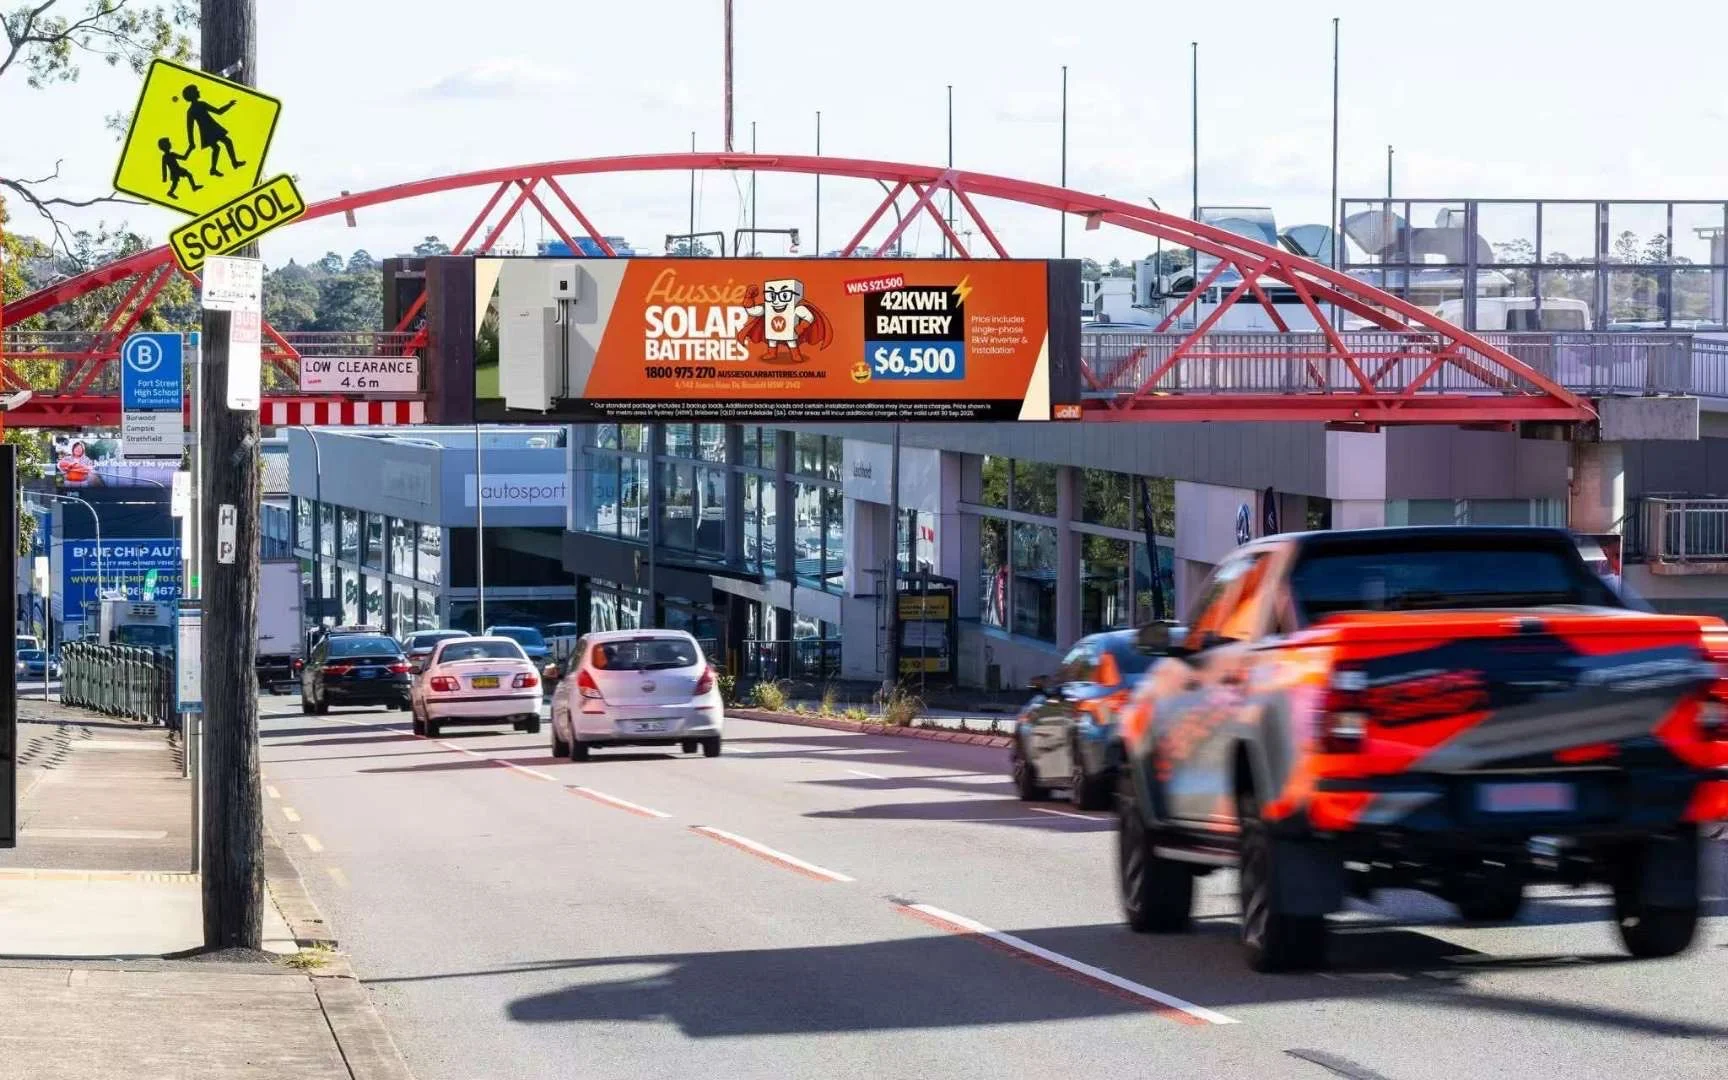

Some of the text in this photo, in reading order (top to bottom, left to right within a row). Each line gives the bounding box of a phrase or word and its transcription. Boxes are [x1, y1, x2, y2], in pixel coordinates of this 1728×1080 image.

[182, 188, 295, 260] SCHOOL
[645, 268, 747, 303] Aussie
[847, 283, 868, 293] WAS
[880, 291, 948, 311] 42KWH
[645, 305, 748, 338] SOLAR
[971, 315, 1025, 323] Price includes
[876, 315, 952, 335] BATTERY
[971, 326, 1024, 335] single-phase
[137, 345, 153, 365] B
[646, 339, 749, 361] BATTERIES
[874, 347, 956, 376] $6,500
[305, 361, 413, 374] LOW CLEARANCE
[645, 367, 672, 378] 1800
[674, 367, 693, 378] 975
[695, 367, 715, 378] 270
[138, 379, 178, 388] Fort Street
[133, 388, 179, 398] High School
[126, 414, 156, 422] Burwood
[126, 424, 155, 434] Campsie
[126, 434, 163, 443] Strathfield
[157, 459, 182, 470] symbo
[481, 483, 567, 502] autosport
[73, 547, 182, 558] BLUE CHIP AUT
